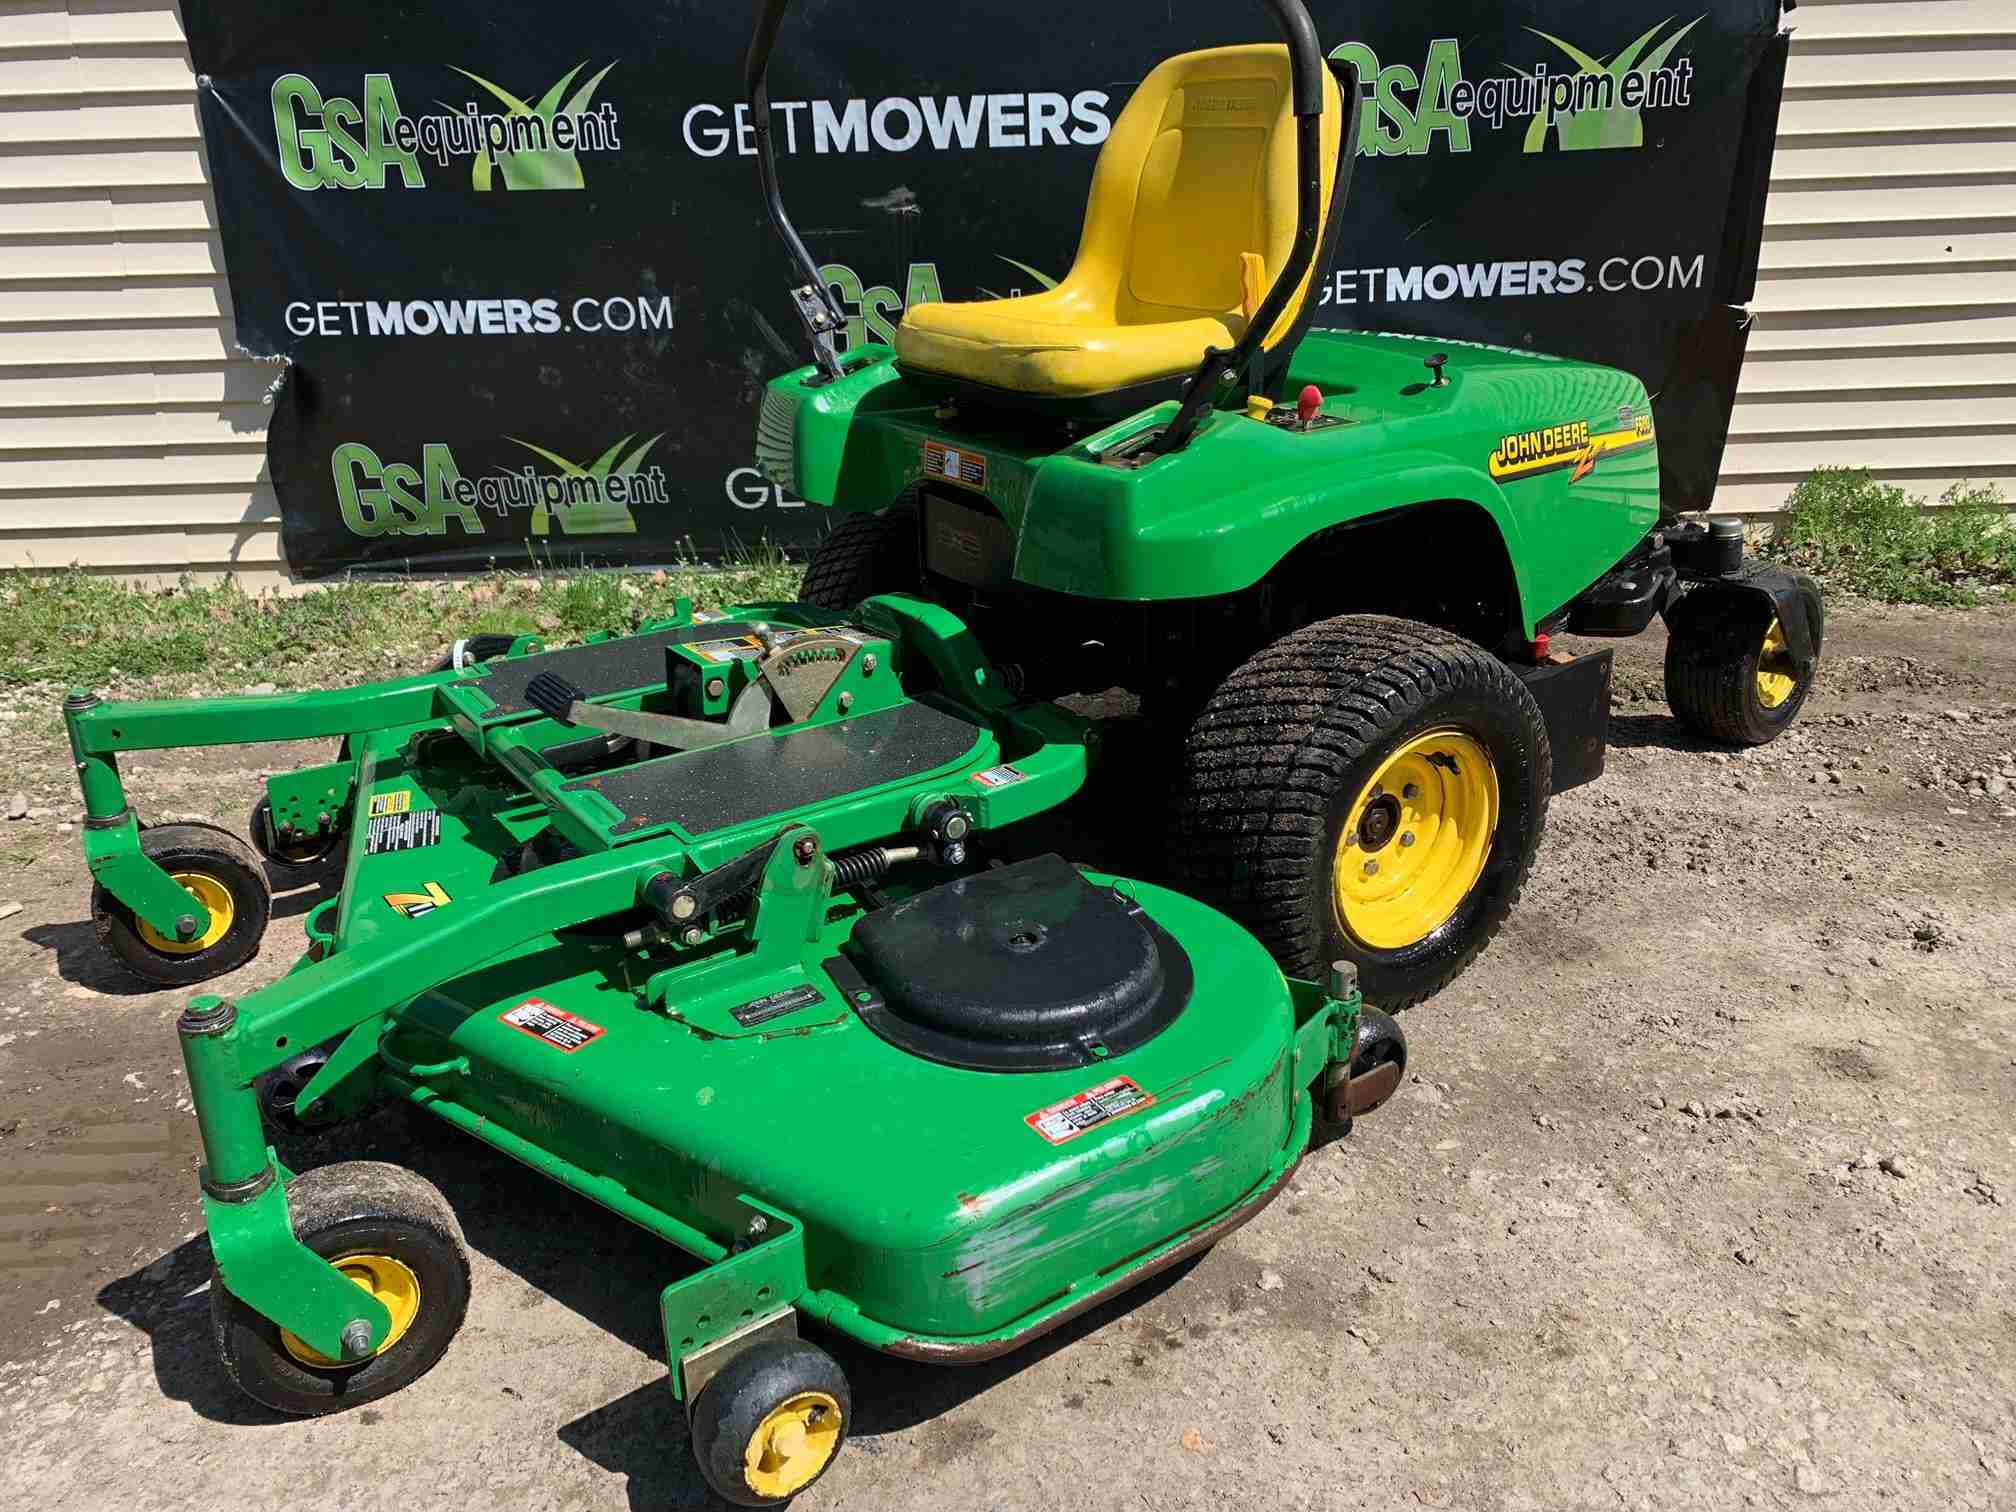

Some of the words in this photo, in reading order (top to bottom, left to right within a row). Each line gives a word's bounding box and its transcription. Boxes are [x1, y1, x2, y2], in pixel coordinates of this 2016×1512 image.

[1449, 58, 1693, 129] equipment
[393, 101, 621, 167] equipment
[285, 296, 674, 336] GETMOWERS.COM
[1497, 431, 1542, 462] JOHN
[1543, 420, 1590, 454] DEERE
[451, 466, 669, 516] equipment
